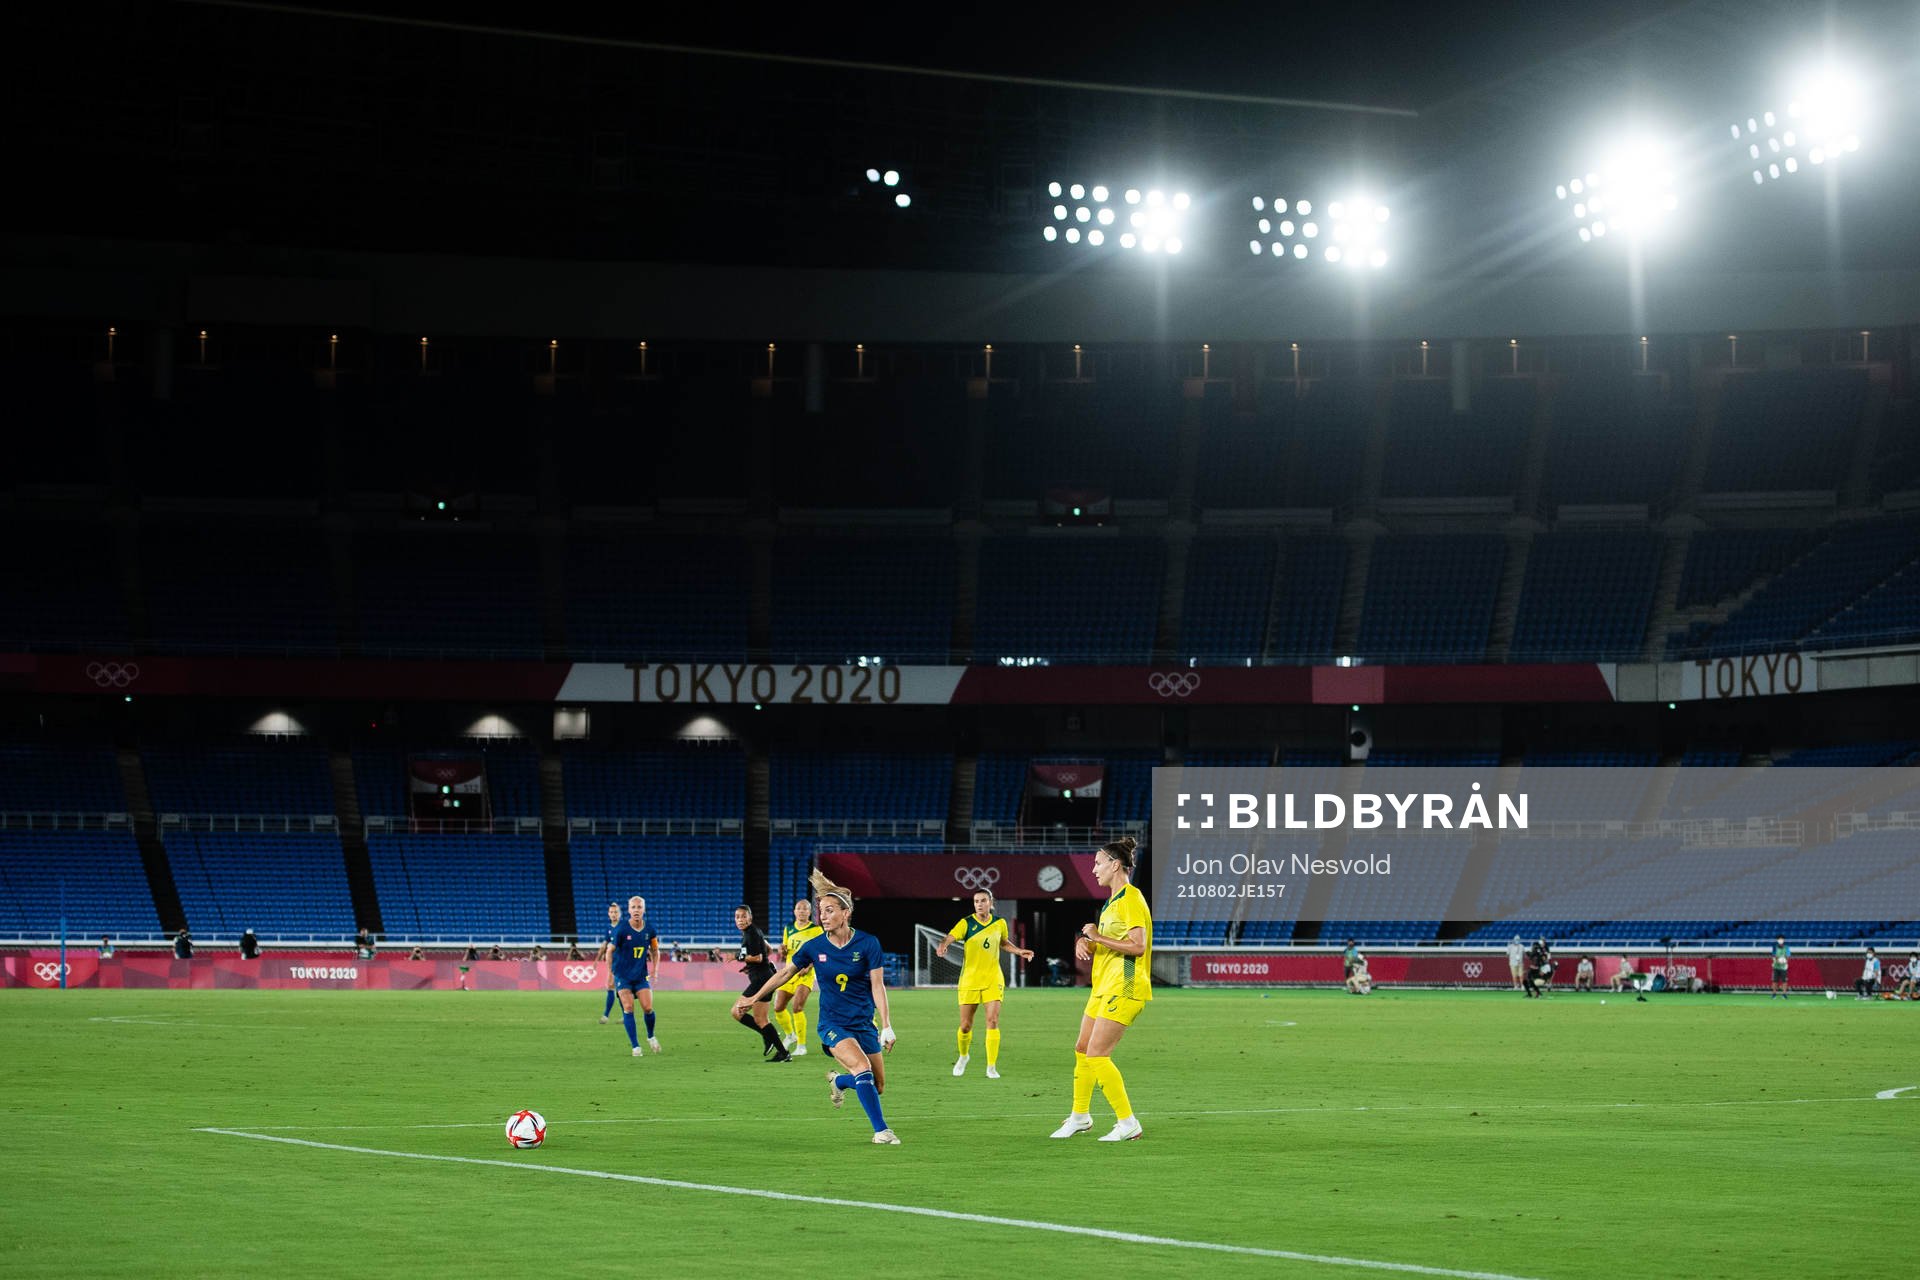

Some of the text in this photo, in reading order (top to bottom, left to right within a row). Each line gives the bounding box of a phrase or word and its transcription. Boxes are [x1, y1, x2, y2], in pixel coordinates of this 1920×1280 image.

[1696, 651, 1802, 702] TOKYO
[625, 663, 902, 704] TOKYO 2020
[791, 939, 801, 950] 17
[983, 938, 990, 949] 6
[632, 946, 645, 959] 17
[290, 967, 358, 980] TOKYO 2020
[1205, 963, 1269, 974] TOKYO 2020
[835, 973, 849, 992] 9
